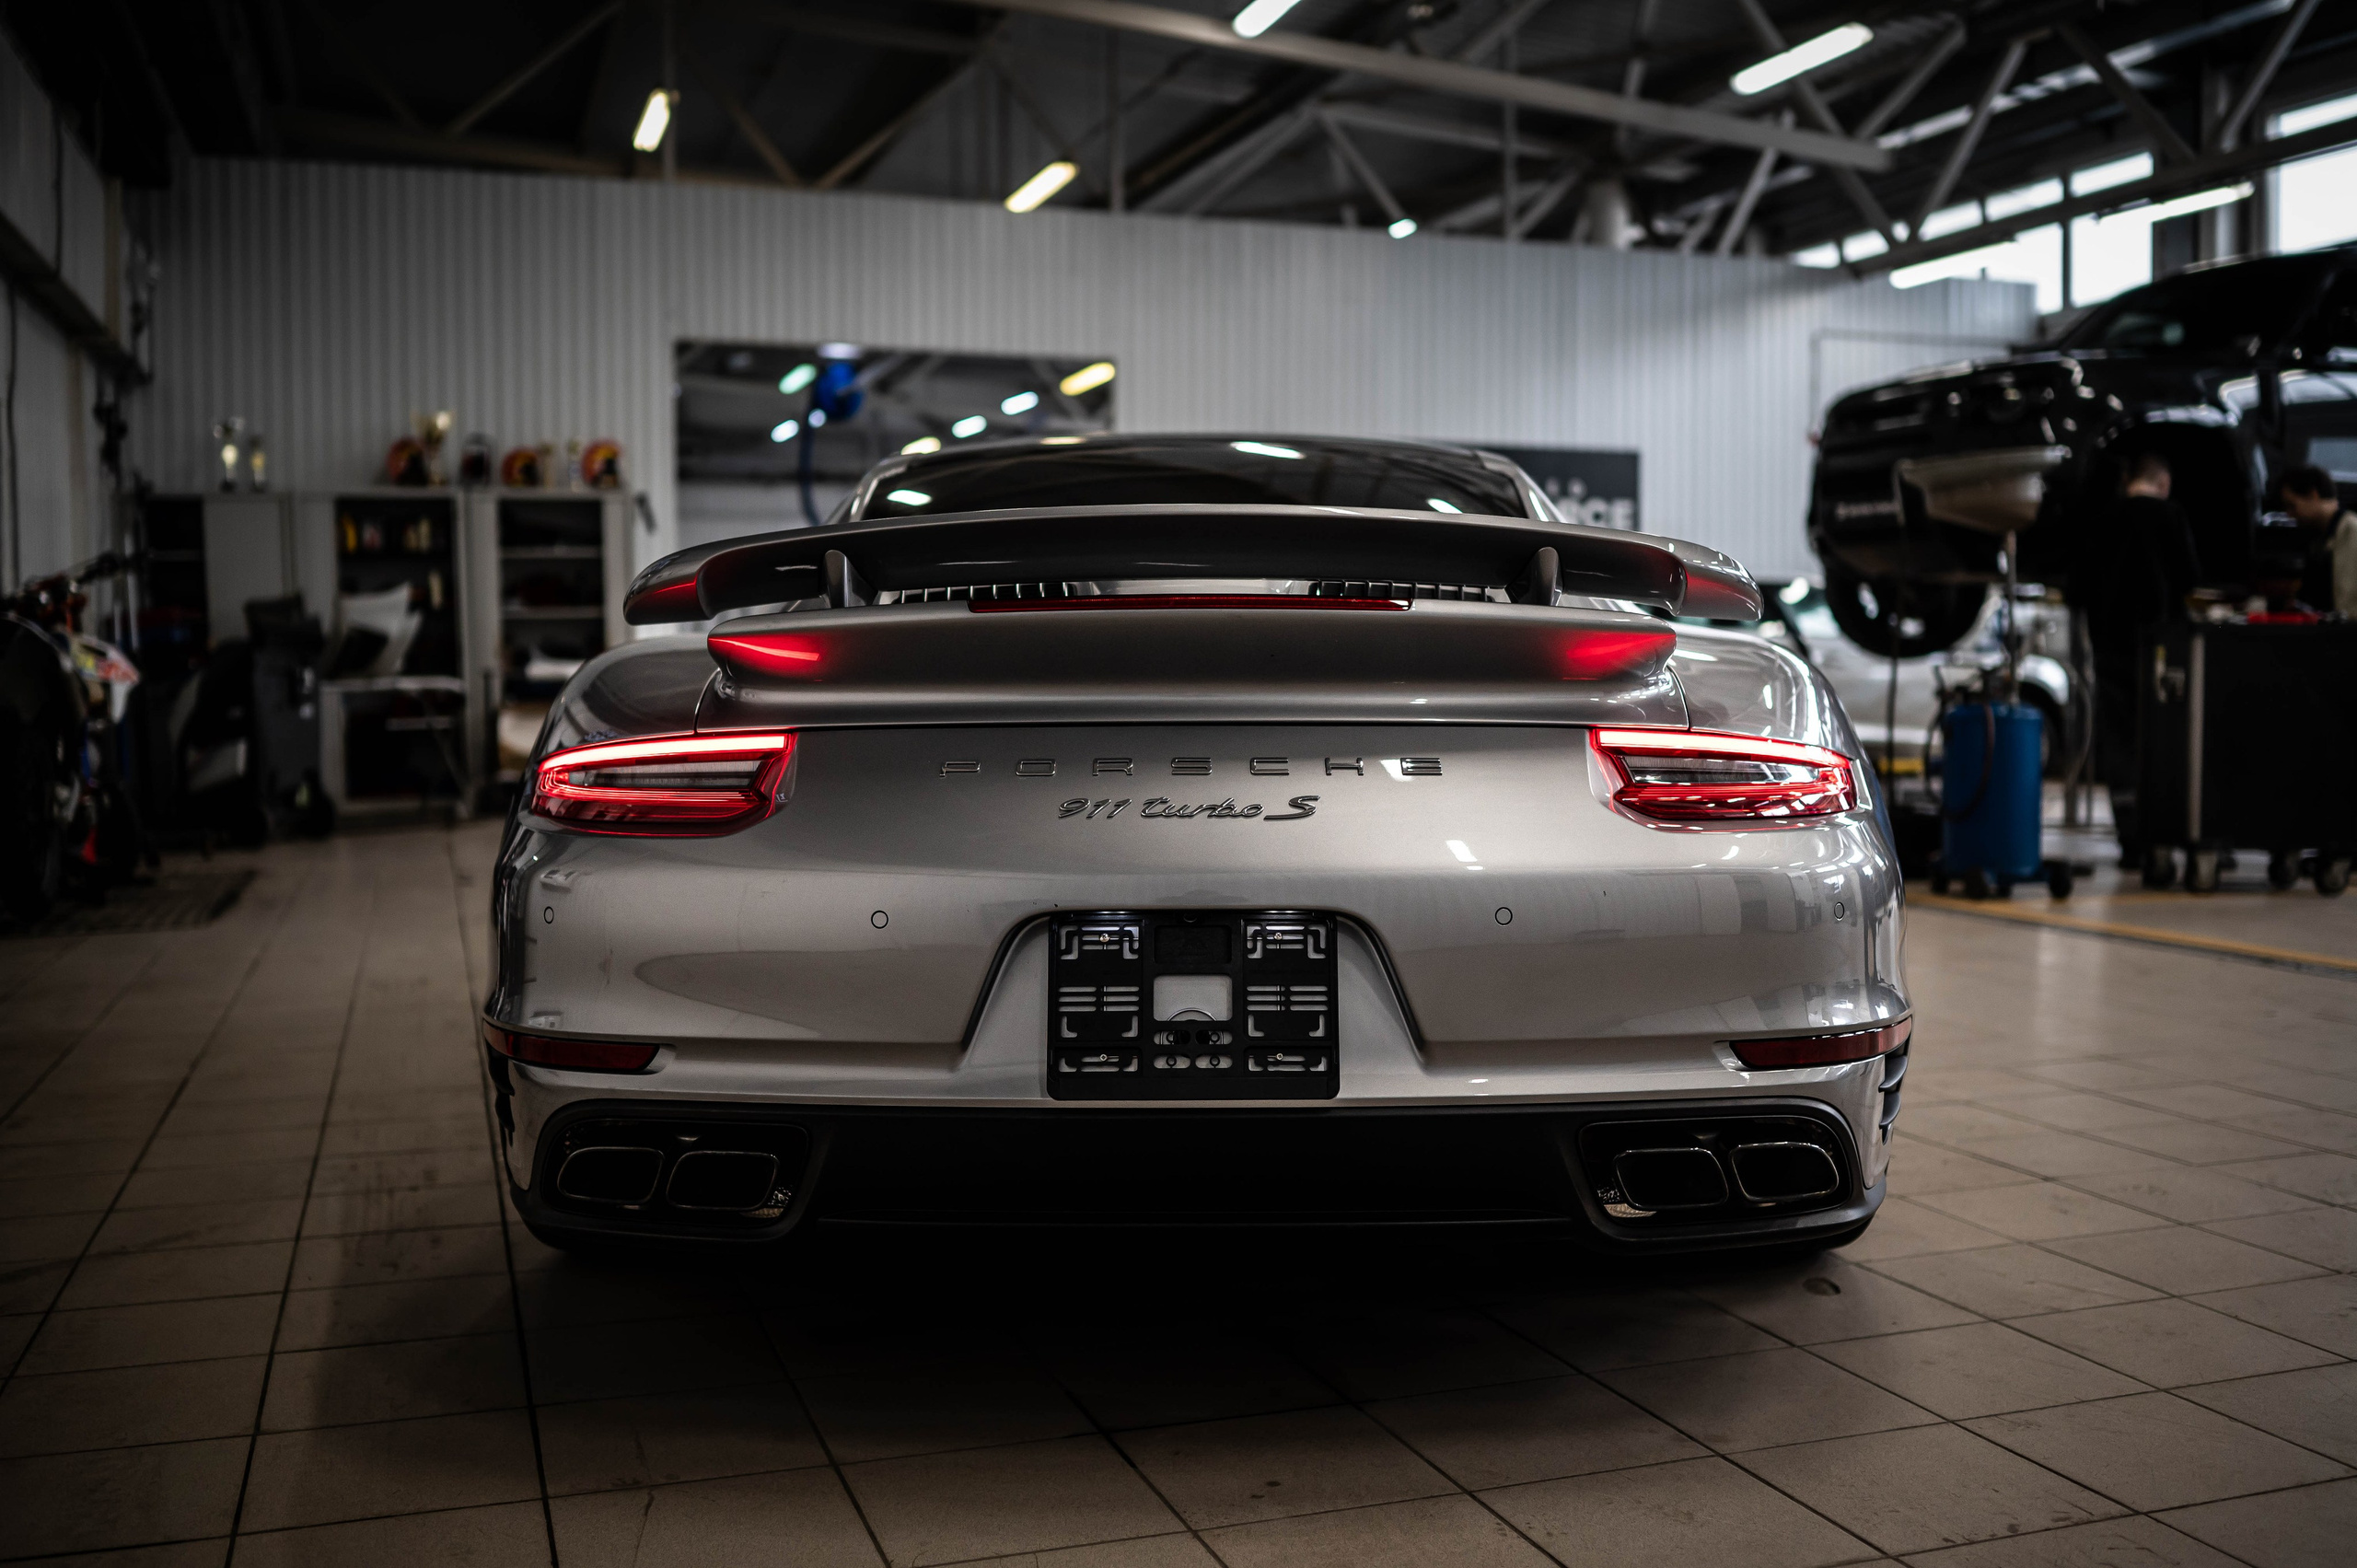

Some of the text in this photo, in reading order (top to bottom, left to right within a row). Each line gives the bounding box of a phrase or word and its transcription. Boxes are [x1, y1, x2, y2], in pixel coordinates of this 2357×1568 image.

[939, 757, 1443, 777] PORSCHE
[1058, 795, 1321, 820] 911 turbo S
